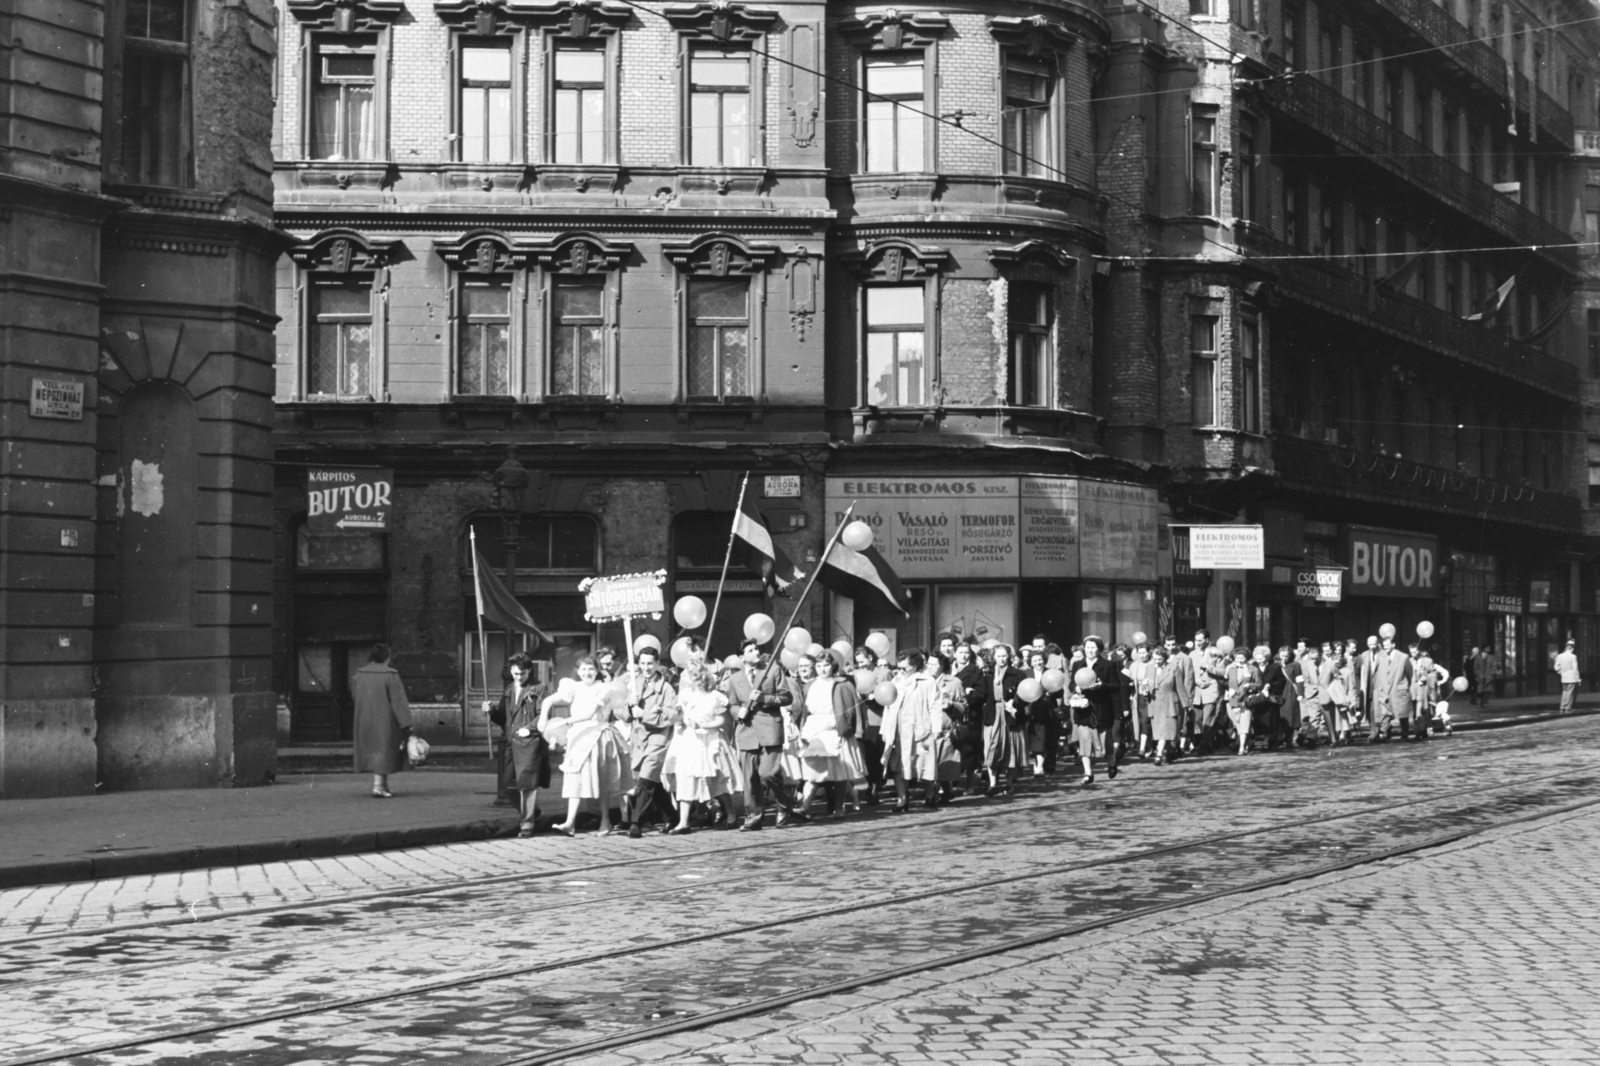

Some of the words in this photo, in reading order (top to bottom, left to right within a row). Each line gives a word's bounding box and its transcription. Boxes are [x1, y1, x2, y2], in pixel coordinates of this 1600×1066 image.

[309, 470, 356, 482] KÁRPITOS
[843, 482, 977, 494] ELEKTROMOS
[308, 481, 391, 516] BUTOR
[377, 511, 385, 522] 7
[897, 512, 948, 527] VASALÓ
[960, 515, 1015, 526] TERMOFOR
[1195, 533, 1258, 541] ELEKTROMOS
[1352, 541, 1433, 588] BUTOR
[1297, 572, 1339, 585] CSOKROK
